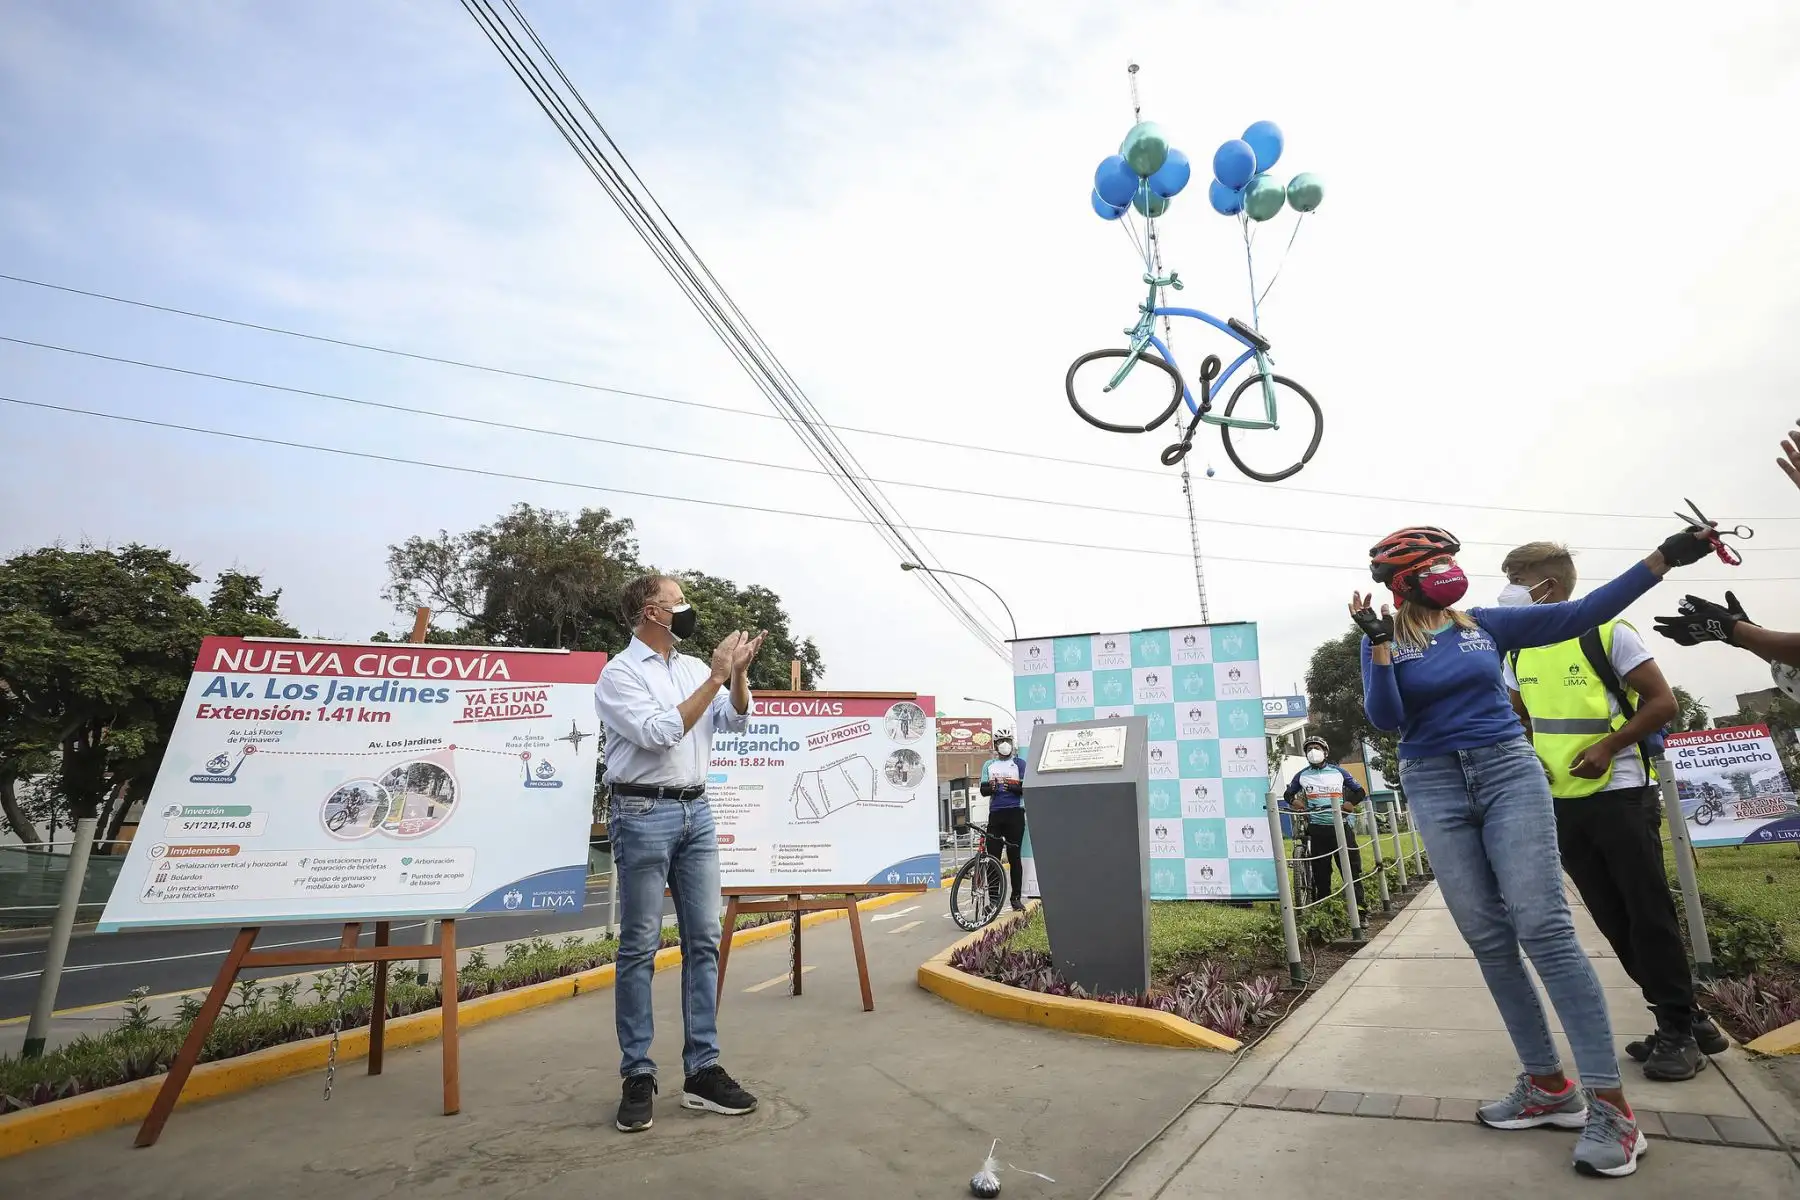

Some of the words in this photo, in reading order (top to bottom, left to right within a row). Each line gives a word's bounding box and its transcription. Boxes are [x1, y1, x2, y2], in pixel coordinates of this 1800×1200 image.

[1460, 644, 1496, 653] LIMA
[1098, 656, 1125, 666] LIMA
[1177, 652, 1206, 661] LIMA
[212, 648, 344, 674] NUEVA
[352, 654, 511, 680] CICLOVÍA
[1024, 662, 1048, 671] LIMA
[201, 676, 254, 698] Av.
[264, 678, 319, 700] Los
[323, 680, 450, 705] Jardines
[1139, 690, 1168, 700] LIMA
[1222, 686, 1252, 696] LIMA
[465, 694, 486, 706] YA
[491, 692, 508, 704] ES
[513, 690, 548, 702] UNA
[1061, 694, 1087, 704] LIMA
[463, 703, 545, 719] REALIDAD
[752, 699, 843, 716] CICLOVÍAS
[1263, 702, 1282, 711] GO
[196, 704, 312, 722] Extensión:
[317, 706, 354, 722] 1.41
[357, 708, 391, 723] km
[808, 734, 830, 748] MUY
[830, 723, 872, 741] PRONTO
[1182, 726, 1212, 736] LIMA
[1667, 735, 1713, 746] PRIMERA
[1714, 729, 1764, 742] CICLOVÍA
[368, 741, 383, 749] Av.
[386, 740, 402, 748] Los
[404, 737, 442, 747] Jardines
[713, 738, 800, 755] urigancho
[1678, 748, 1696, 758] de
[1698, 746, 1725, 756] San
[1727, 742, 1760, 753] Juan
[710, 757, 737, 767] sión:
[740, 758, 766, 767] 13.82
[767, 758, 785, 767] km
[1675, 760, 1692, 770] de
[1696, 752, 1772, 768] Lurigancho
[1150, 766, 1172, 774] IMA
[1228, 764, 1258, 773] LIMA
[1188, 804, 1217, 812] LIMA
[1734, 802, 1747, 810] YA
[1760, 798, 1785, 807] UNA
[184, 807, 224, 815] Inversión
[1736, 804, 1788, 818] REALIDAD
[170, 847, 230, 856] Implementos
[1235, 845, 1264, 853] LIMA
[175, 861, 219, 870] Señalización
[220, 860, 246, 869] vertical
[252, 860, 288, 868] horizontal
[308, 876, 332, 884] Equipo
[906, 876, 936, 884] LIMA
[182, 891, 216, 899] bicicletas
[1193, 886, 1224, 894] LIMA
[532, 896, 575, 908] LIMA
